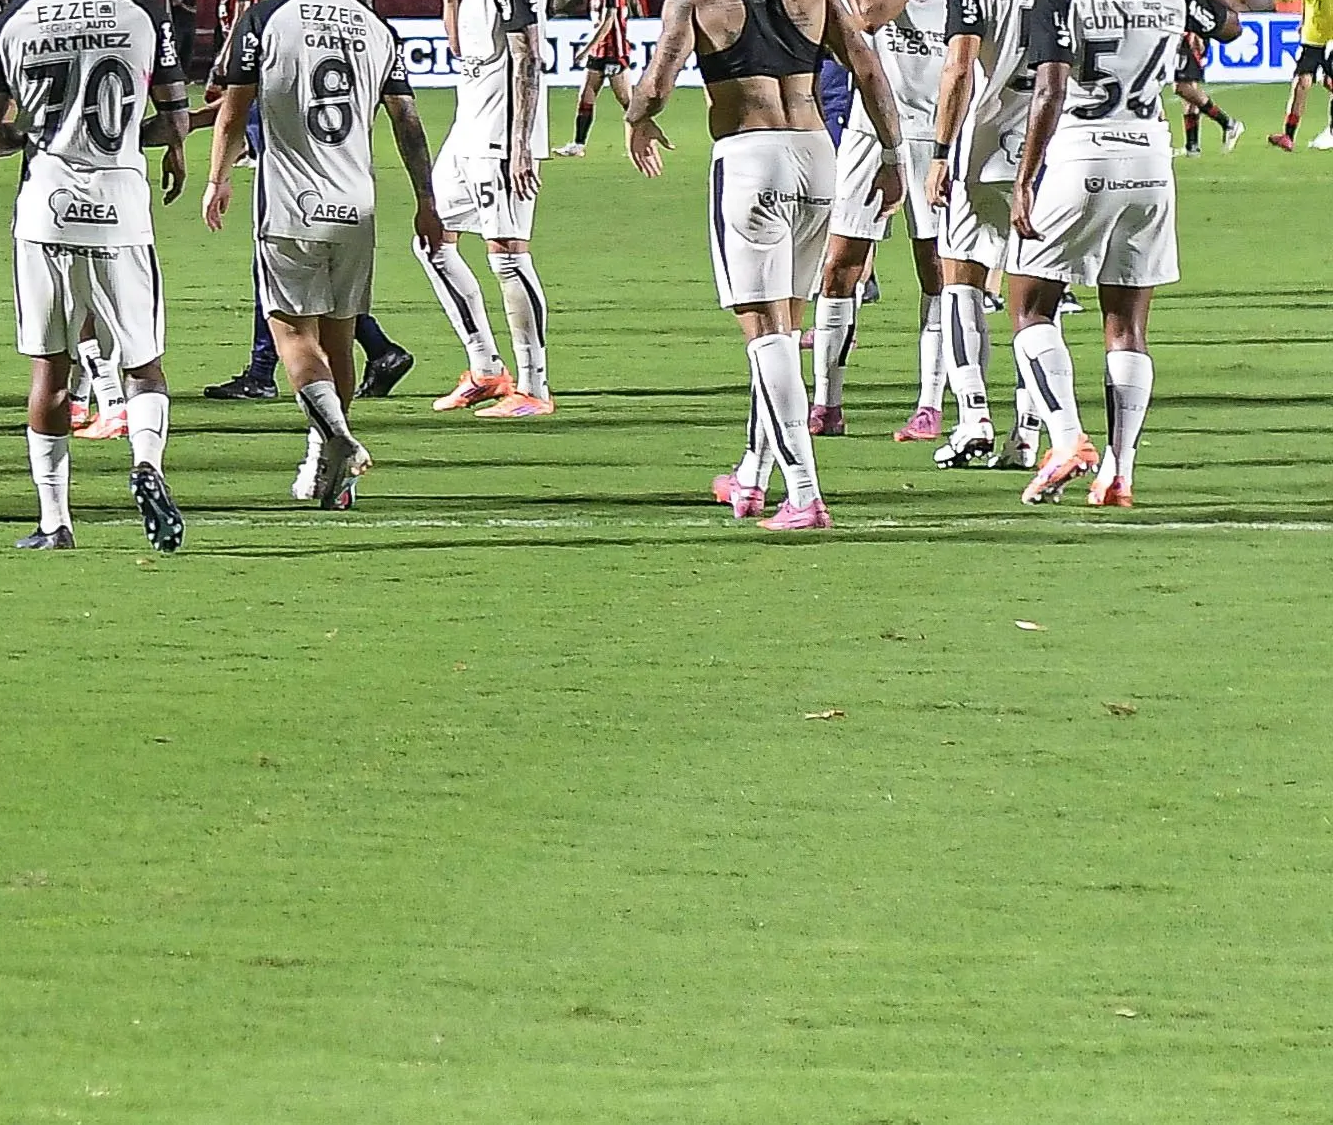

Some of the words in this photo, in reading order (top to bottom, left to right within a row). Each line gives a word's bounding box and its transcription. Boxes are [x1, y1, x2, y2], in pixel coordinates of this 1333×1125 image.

[37, 1, 96, 23] EZZE
[299, 4, 350, 24] EZZE
[39, 22, 83, 34] SEGURO
[85, 20, 116, 29] AUTO
[1084, 13, 1175, 30] GUILHERME
[342, 26, 366, 36] AUTO
[23, 33, 132, 55] MARTINEZ
[305, 34, 366, 52] GARRO
[1070, 35, 1171, 121] 54
[22, 55, 136, 156] 70
[306, 55, 354, 147] 8
[1108, 179, 1168, 191] UniCesumar
[65, 203, 117, 219] AREA
[314, 204, 358, 219] AREA
